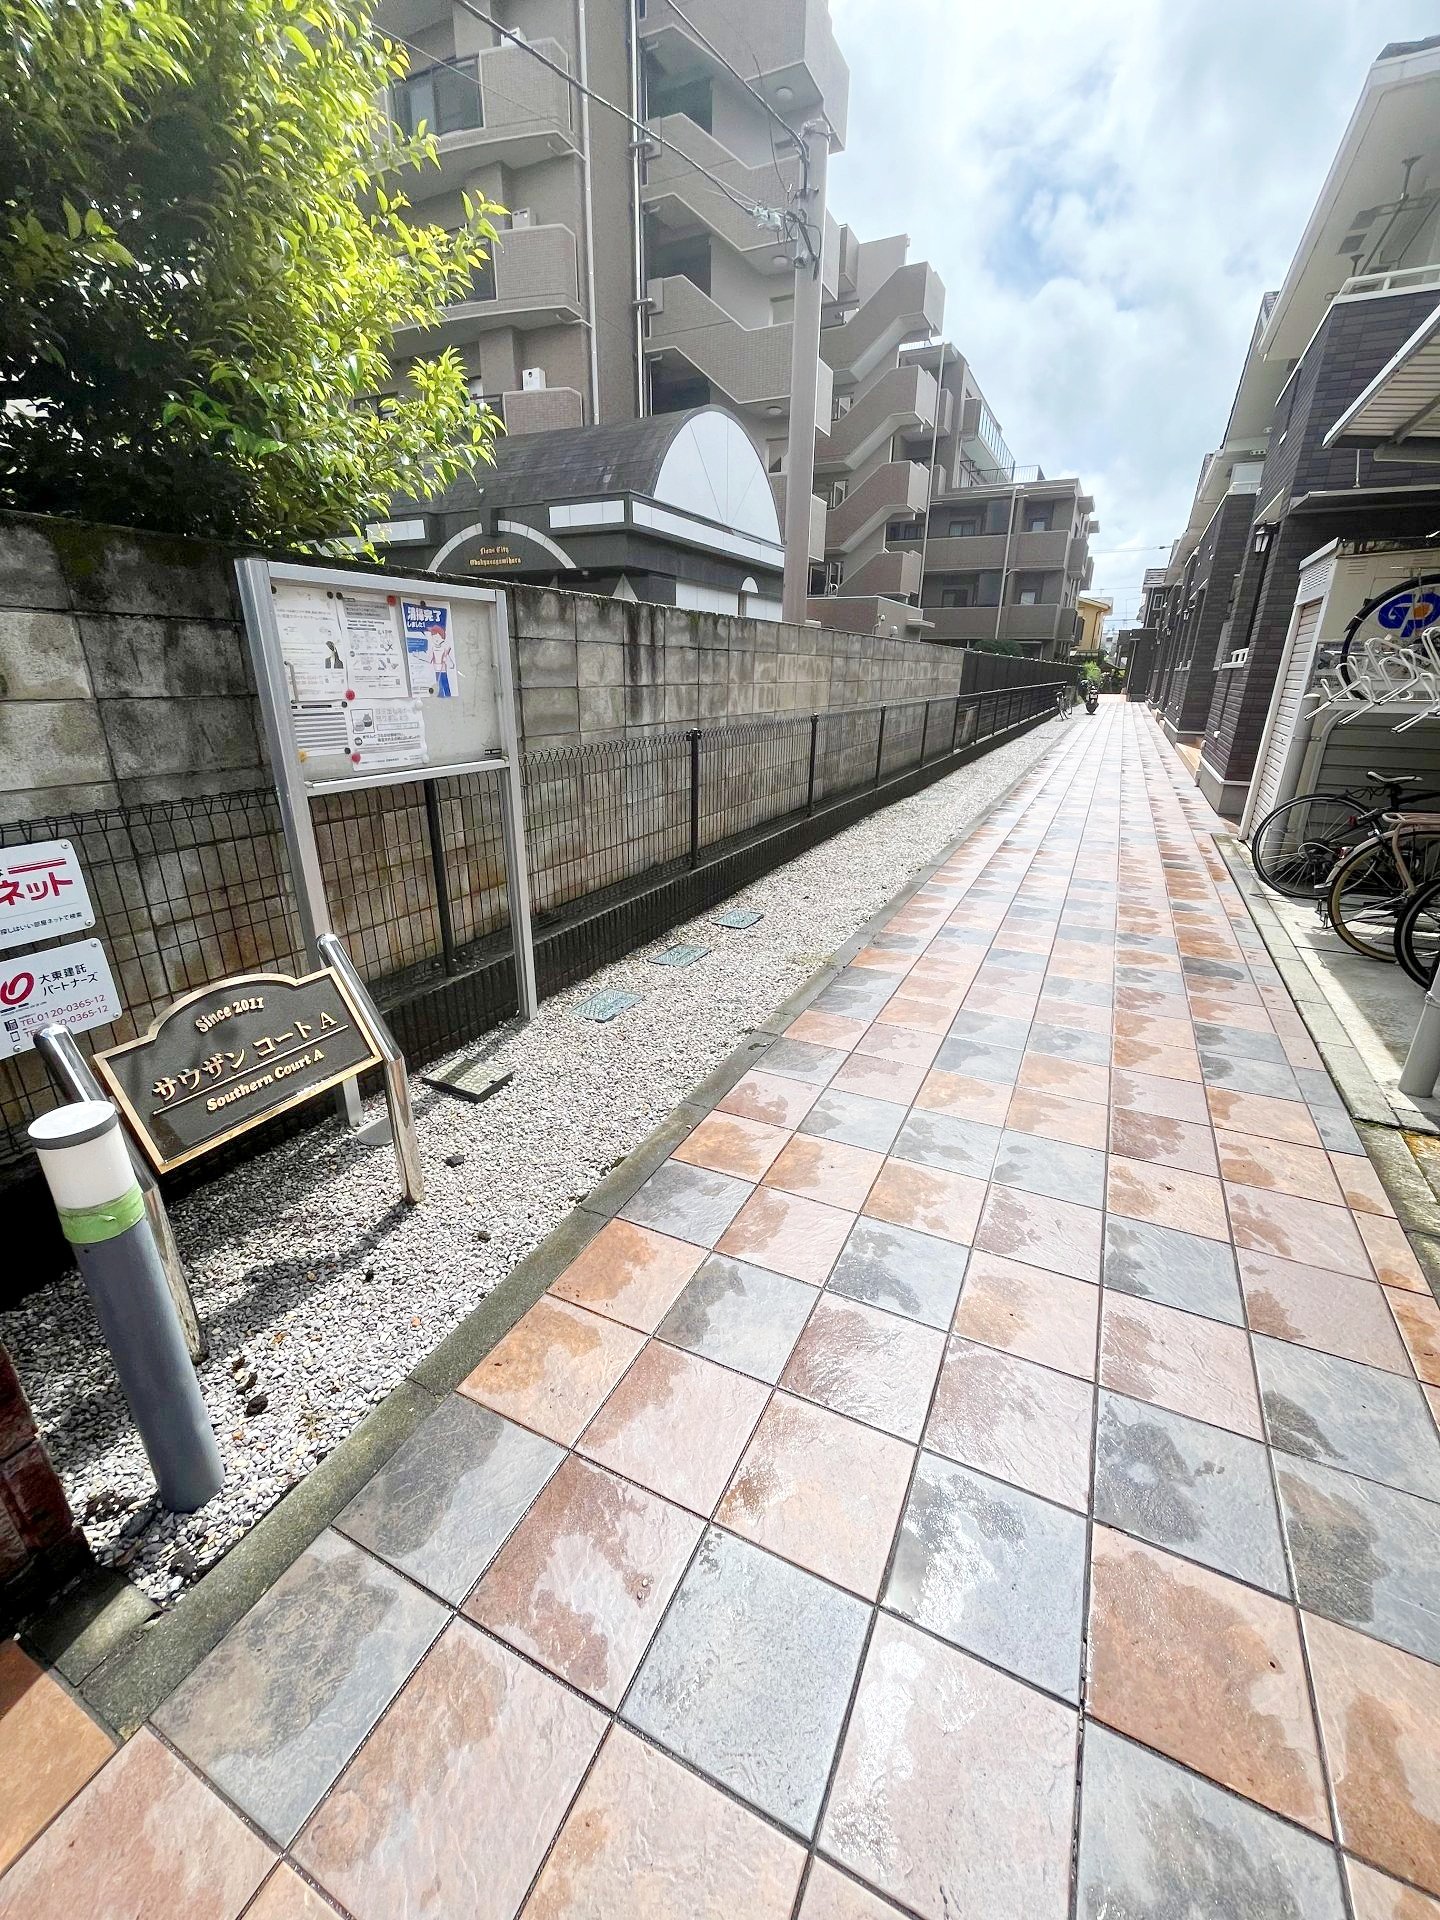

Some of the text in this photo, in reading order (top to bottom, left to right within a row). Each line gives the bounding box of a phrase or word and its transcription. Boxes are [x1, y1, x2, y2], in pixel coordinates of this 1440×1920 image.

[38, 963, 87, 985] 大東建託
[43, 971, 99, 996] パートナーズ
[195, 997, 265, 1033] Since 2011
[153, 1011, 338, 1101] サウザン コート A
[206, 1049, 325, 1112] Southern Court A
